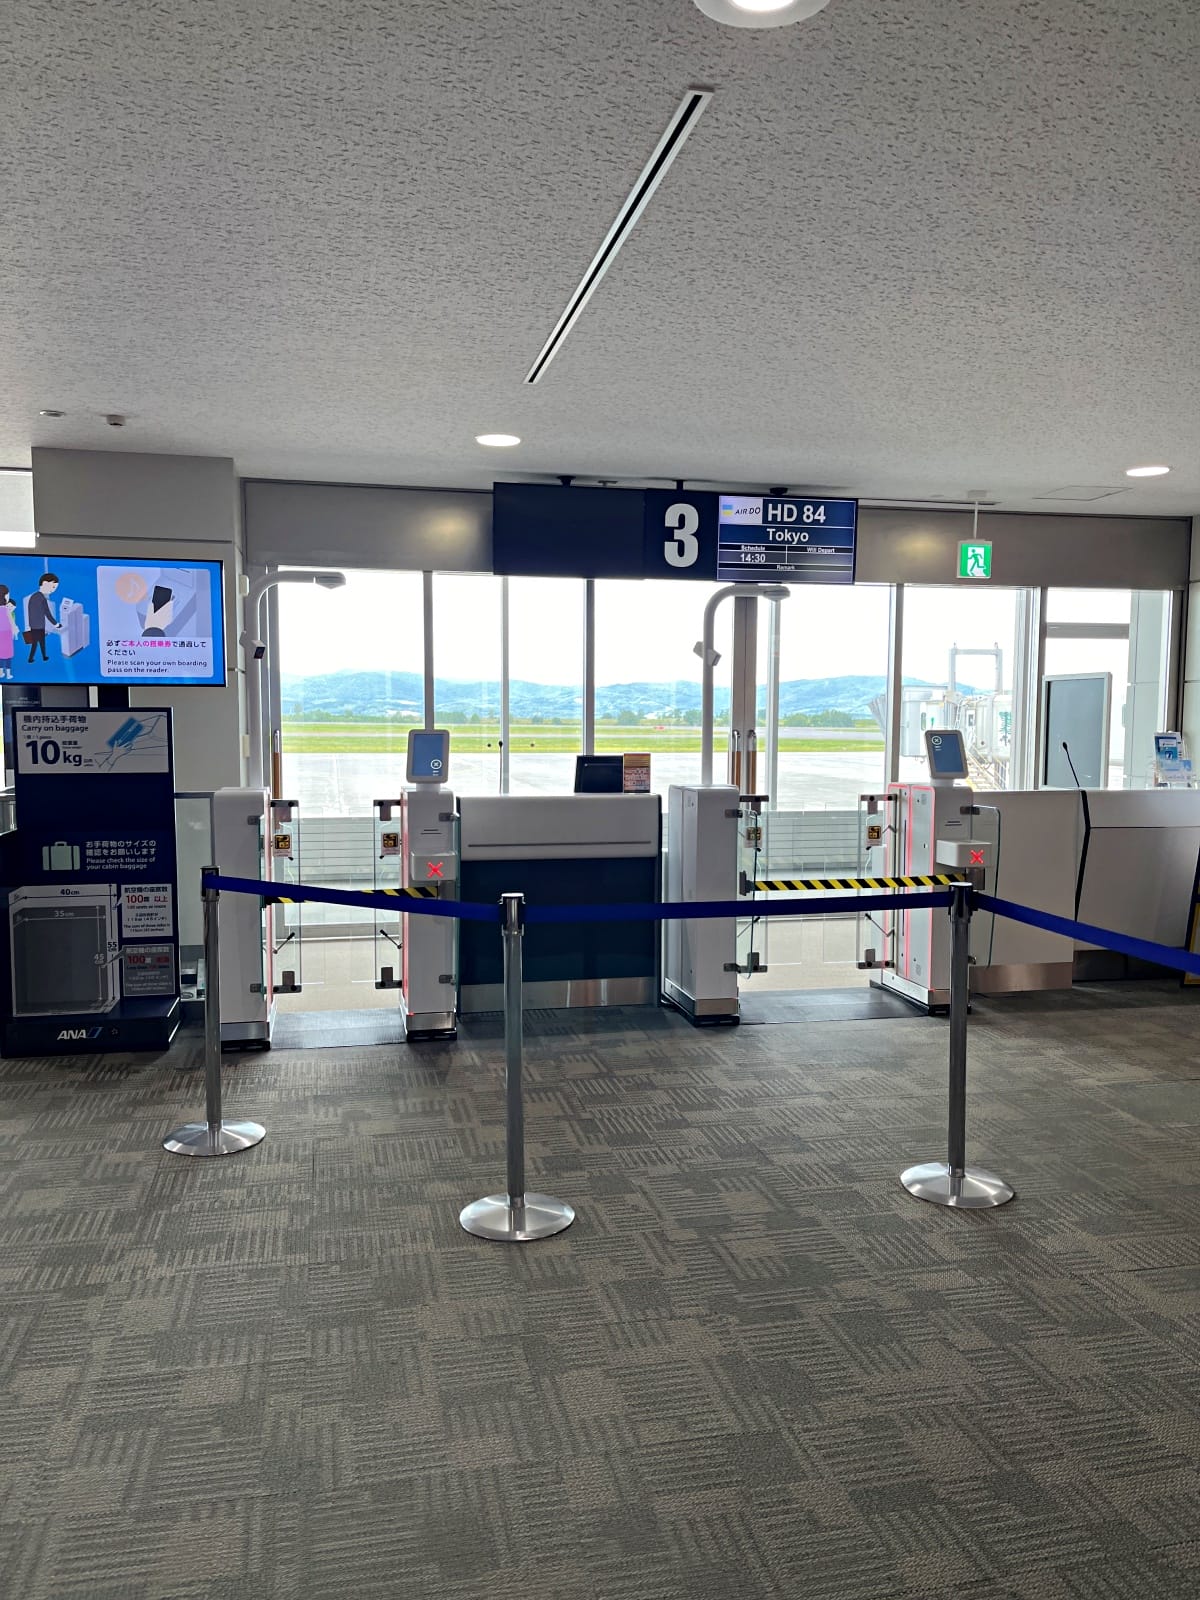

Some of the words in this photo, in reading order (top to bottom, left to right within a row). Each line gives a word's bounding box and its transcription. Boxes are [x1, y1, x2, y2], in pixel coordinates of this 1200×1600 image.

[767, 503, 798, 522] HD
[802, 504, 826, 523] 84
[663, 503, 698, 568] 3
[766, 528, 809, 544] Tokyo
[740, 553, 766, 563] 14:30
[177, 660, 207, 668] boarding
[21, 725, 42, 733] Carry
[55, 724, 89, 733] baggage
[25, 740, 60, 765] 10
[63, 751, 82, 767] kg
[57, 1029, 87, 1040] ANA
